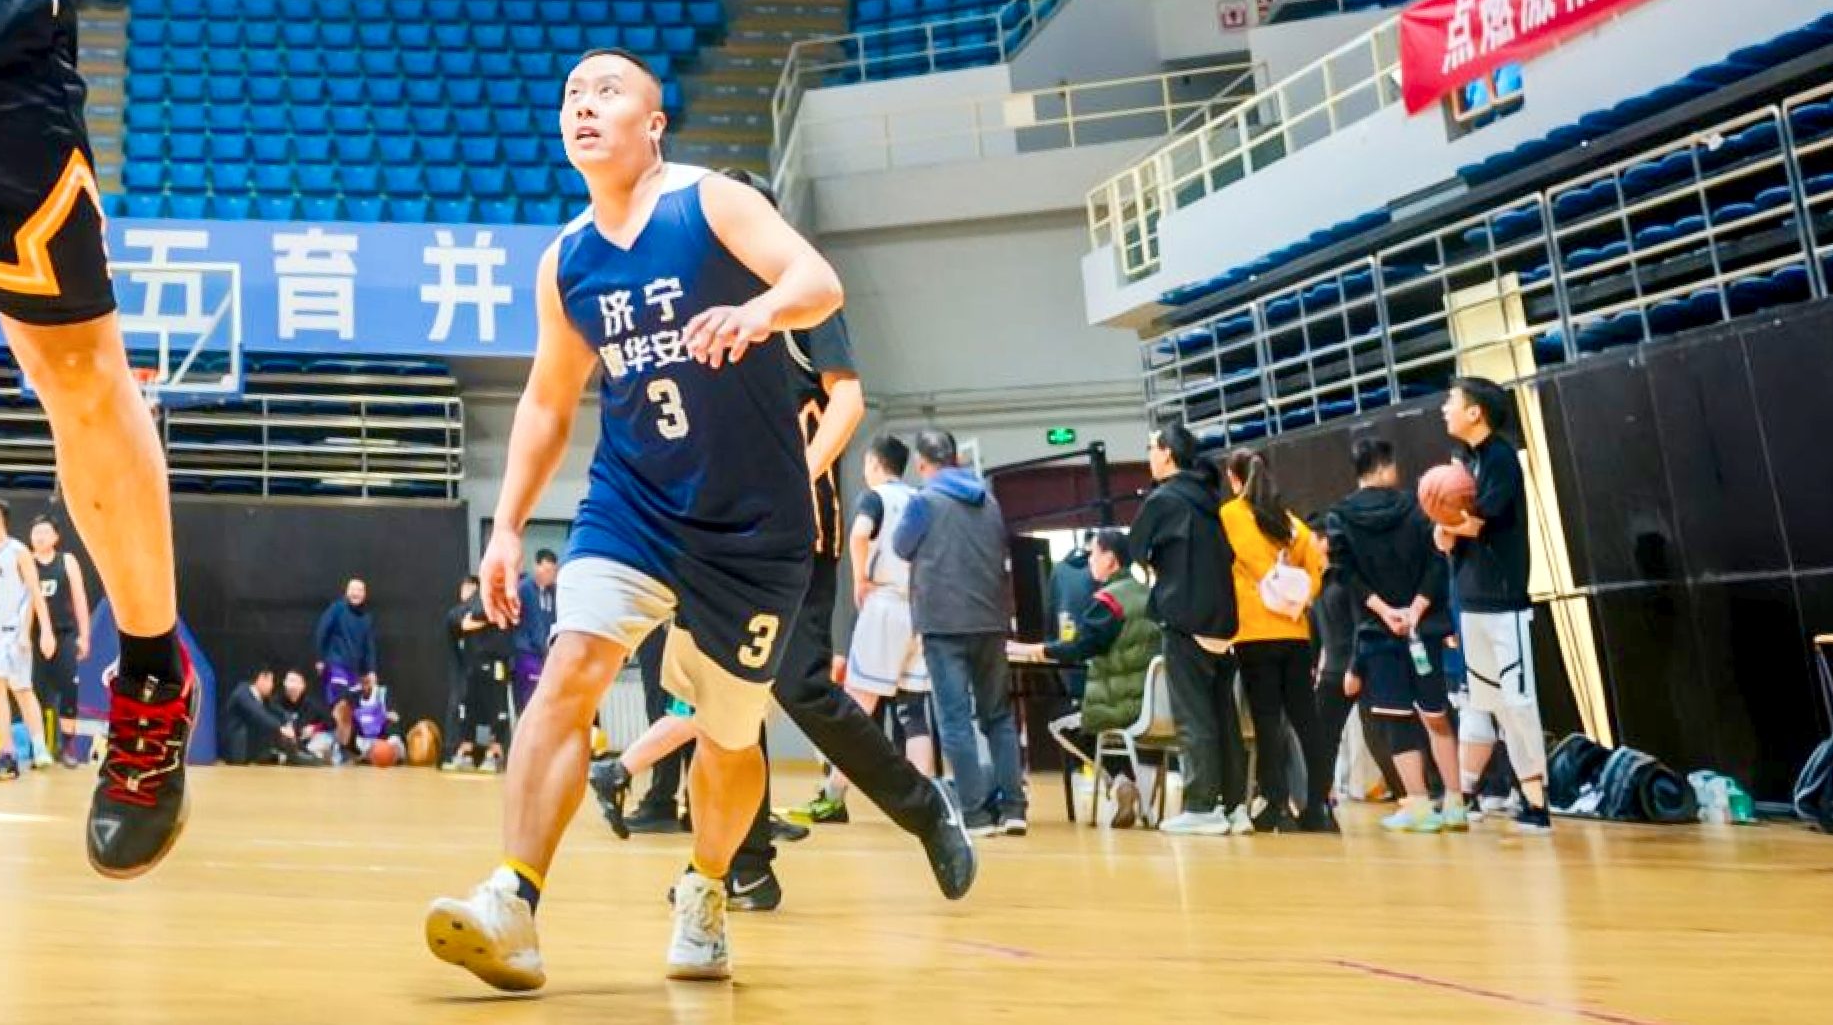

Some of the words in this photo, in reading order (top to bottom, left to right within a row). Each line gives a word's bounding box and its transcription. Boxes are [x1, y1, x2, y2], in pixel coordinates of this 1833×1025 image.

[599, 330, 696, 378] 华安
[646, 378, 690, 440] 3
[738, 615, 781, 668] 3
